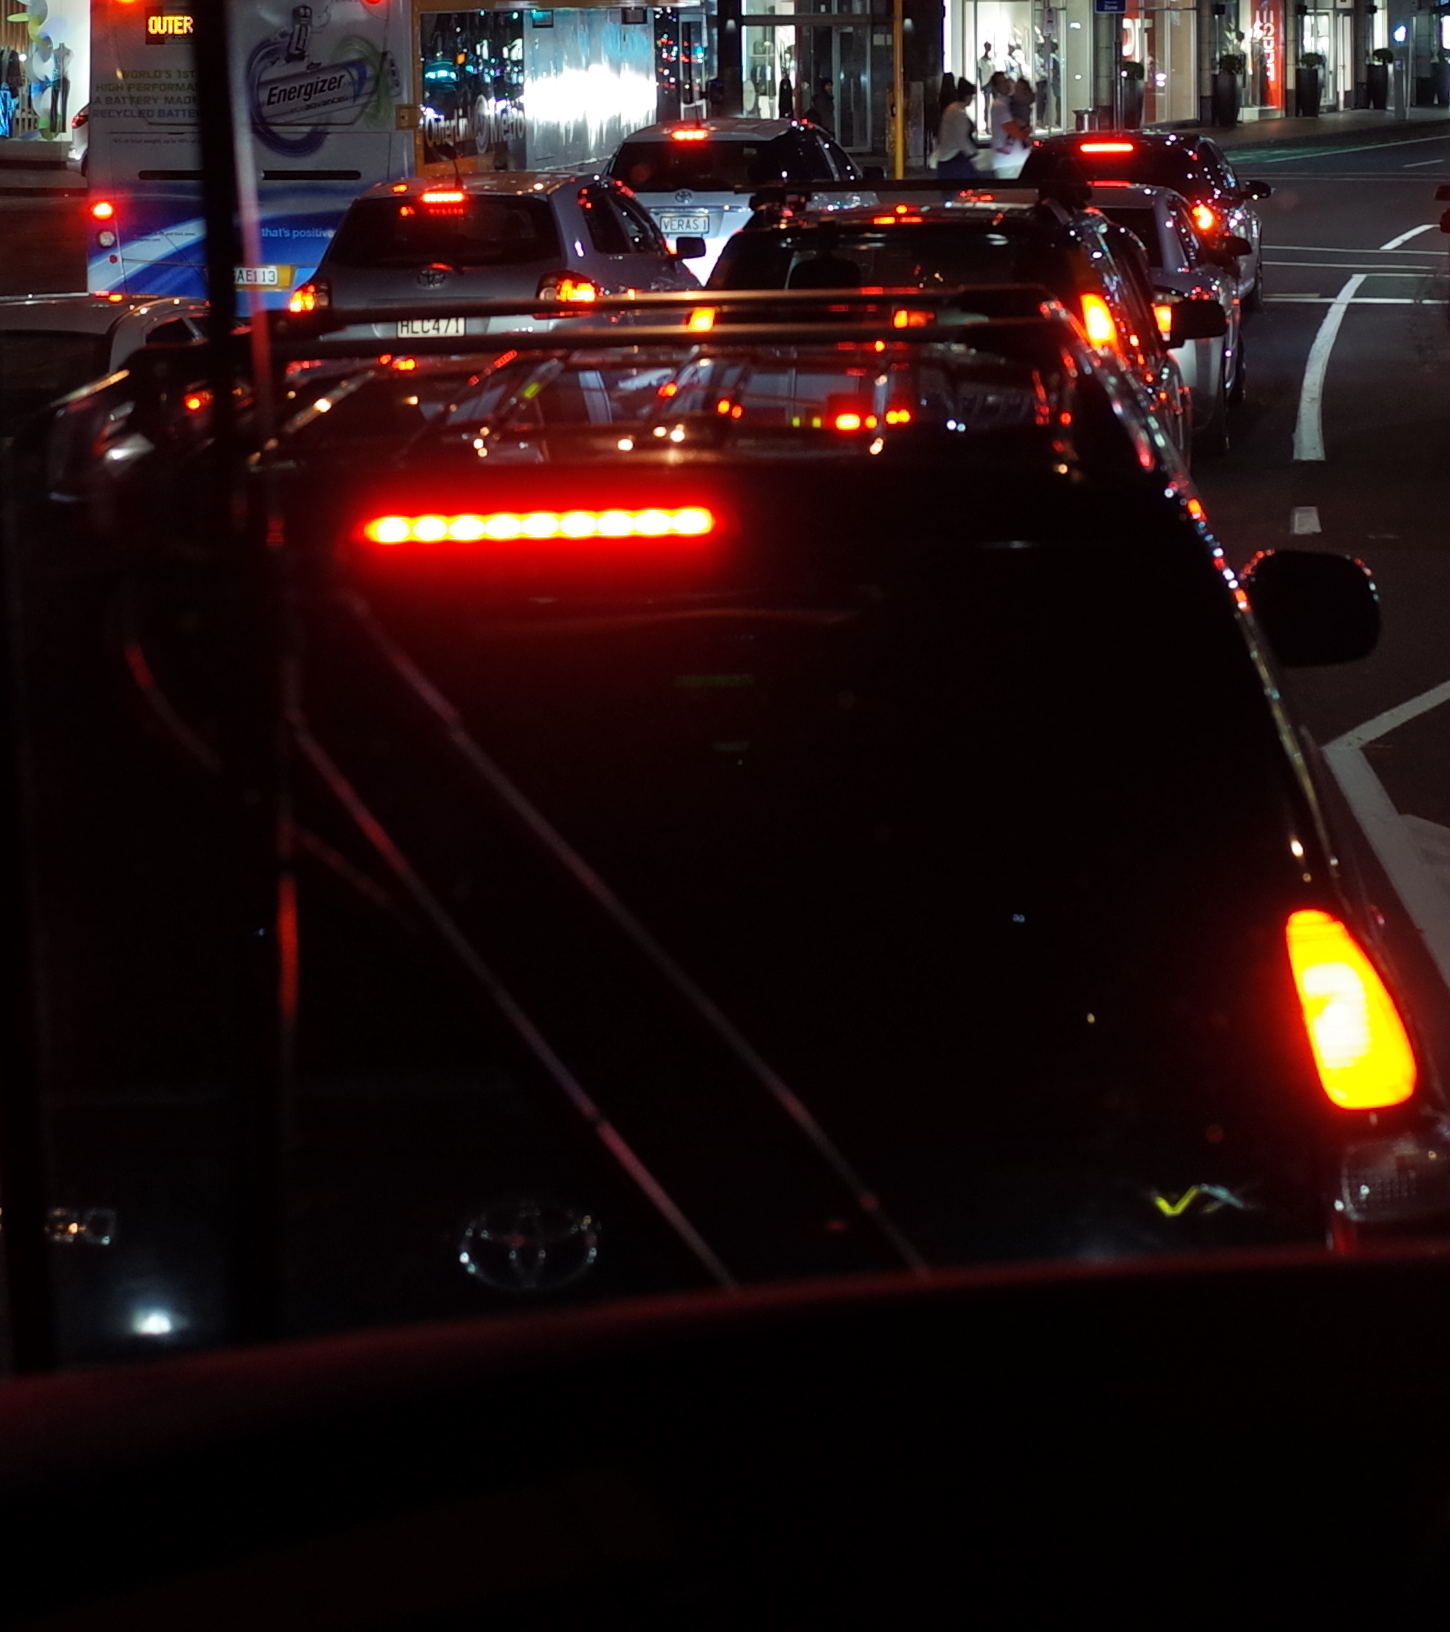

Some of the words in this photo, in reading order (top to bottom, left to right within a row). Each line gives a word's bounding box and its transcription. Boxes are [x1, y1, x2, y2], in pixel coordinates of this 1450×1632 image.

[147, 15, 195, 36] OUTER
[266, 74, 346, 106] Energizer
[261, 228, 290, 238] that's
